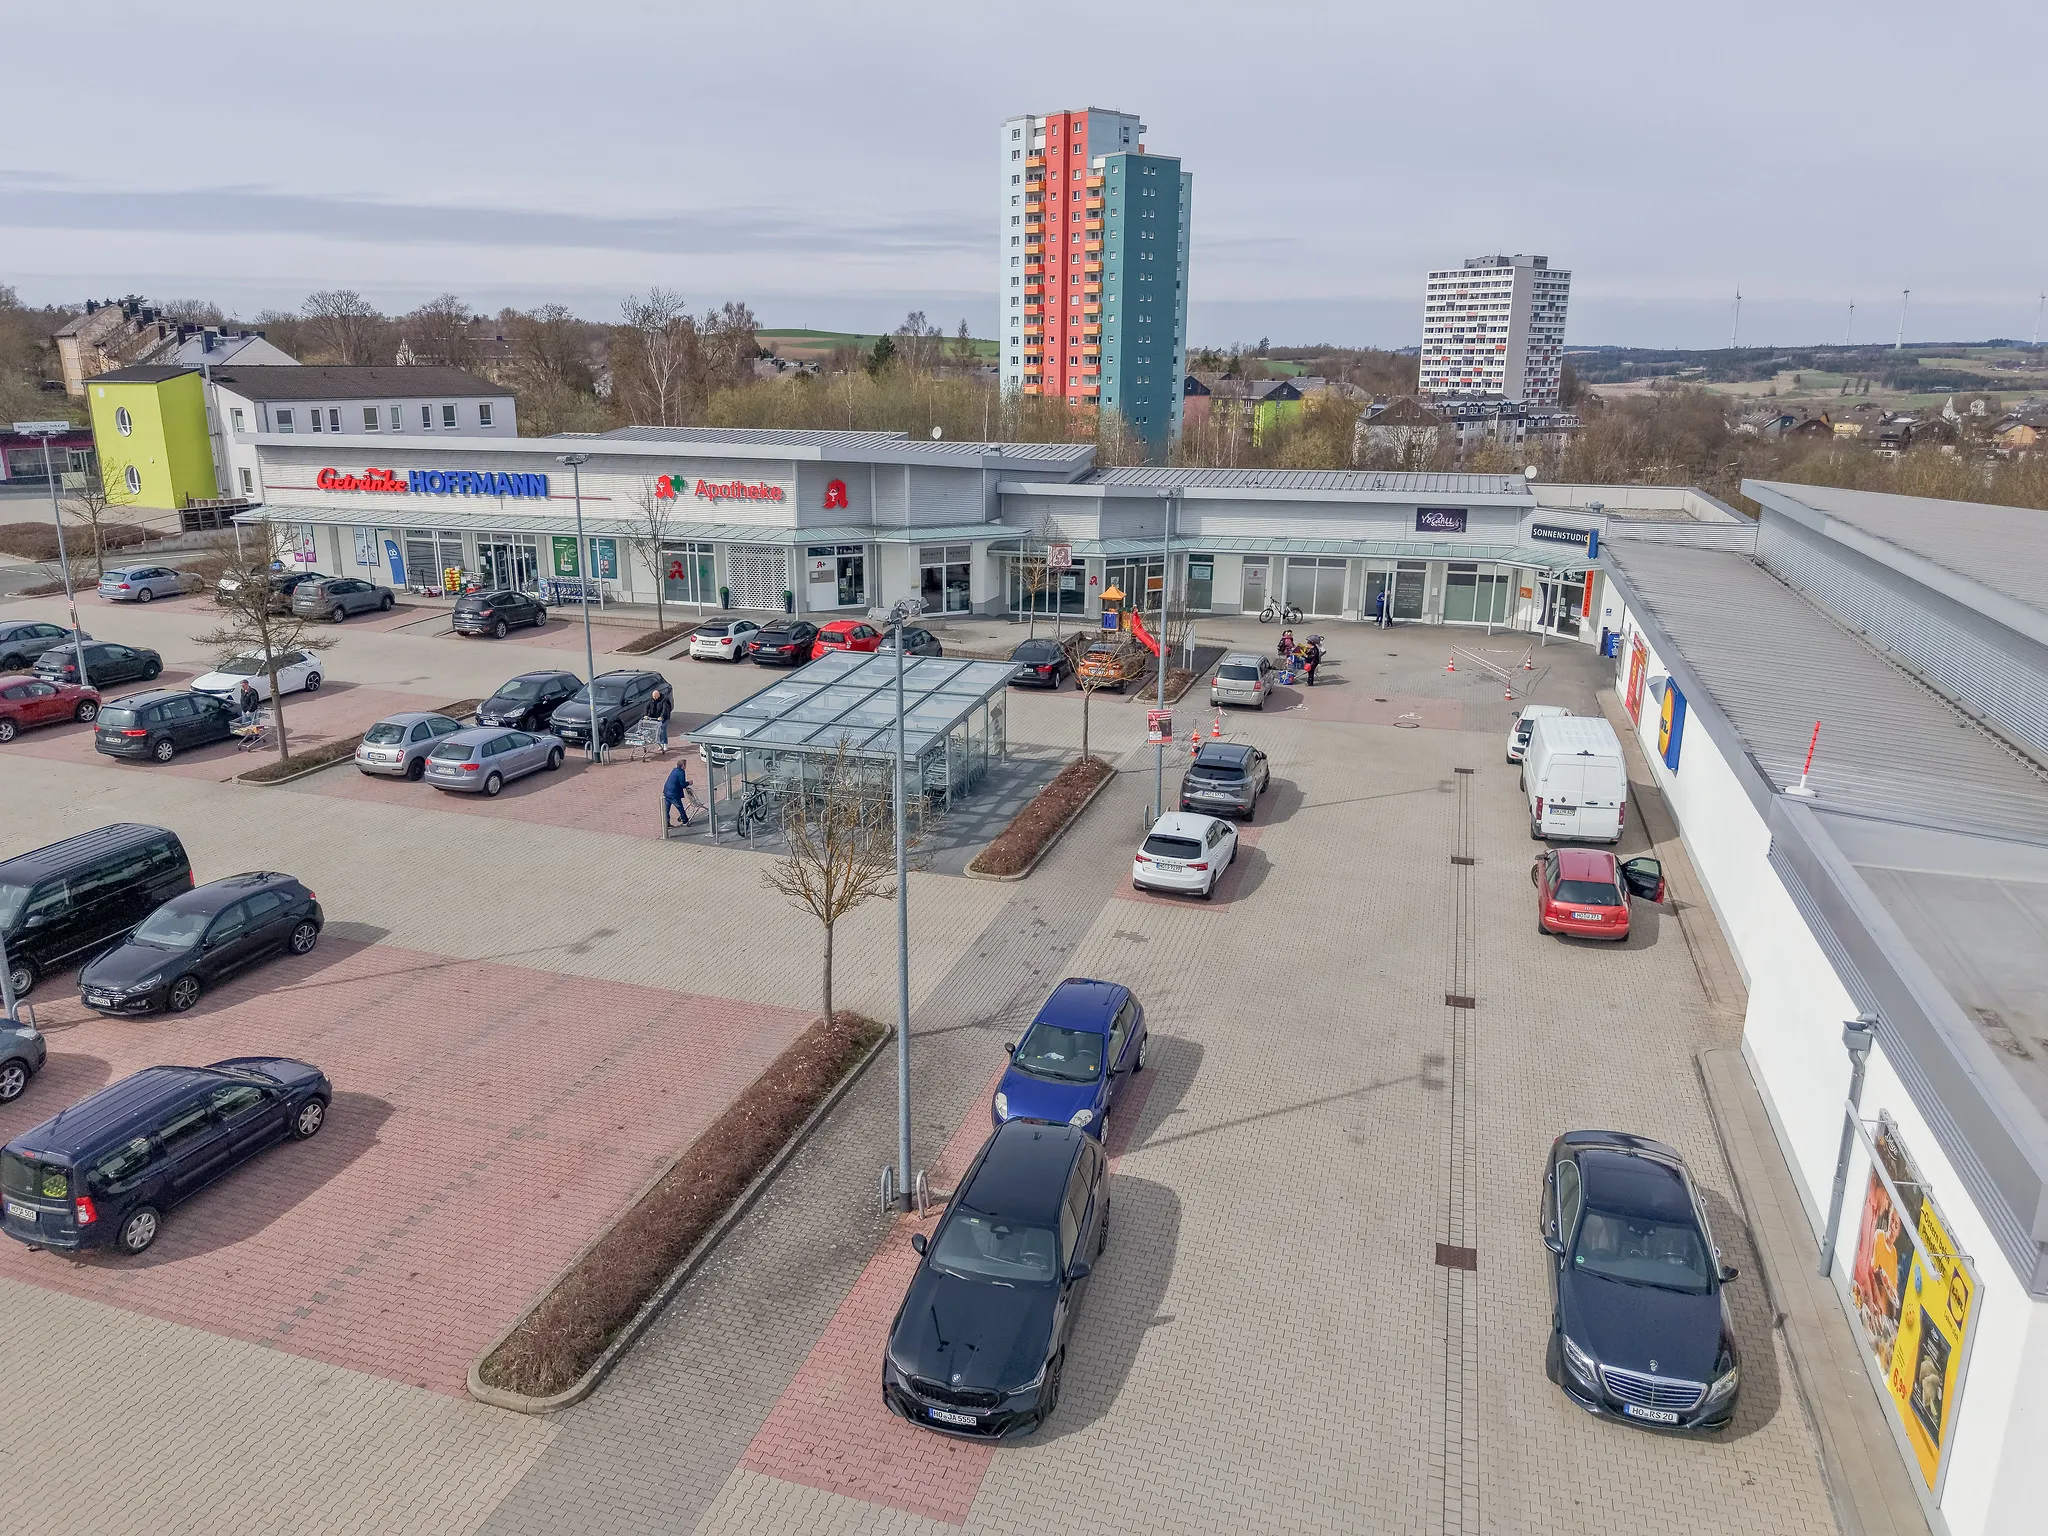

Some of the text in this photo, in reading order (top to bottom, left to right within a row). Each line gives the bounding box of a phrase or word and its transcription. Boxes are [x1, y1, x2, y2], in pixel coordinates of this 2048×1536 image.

[316, 467, 549, 497] Getränke HOFFMANN
[694, 478, 784, 502] Apotheke
[1632, 1407, 1674, 1421] HO RS 20
